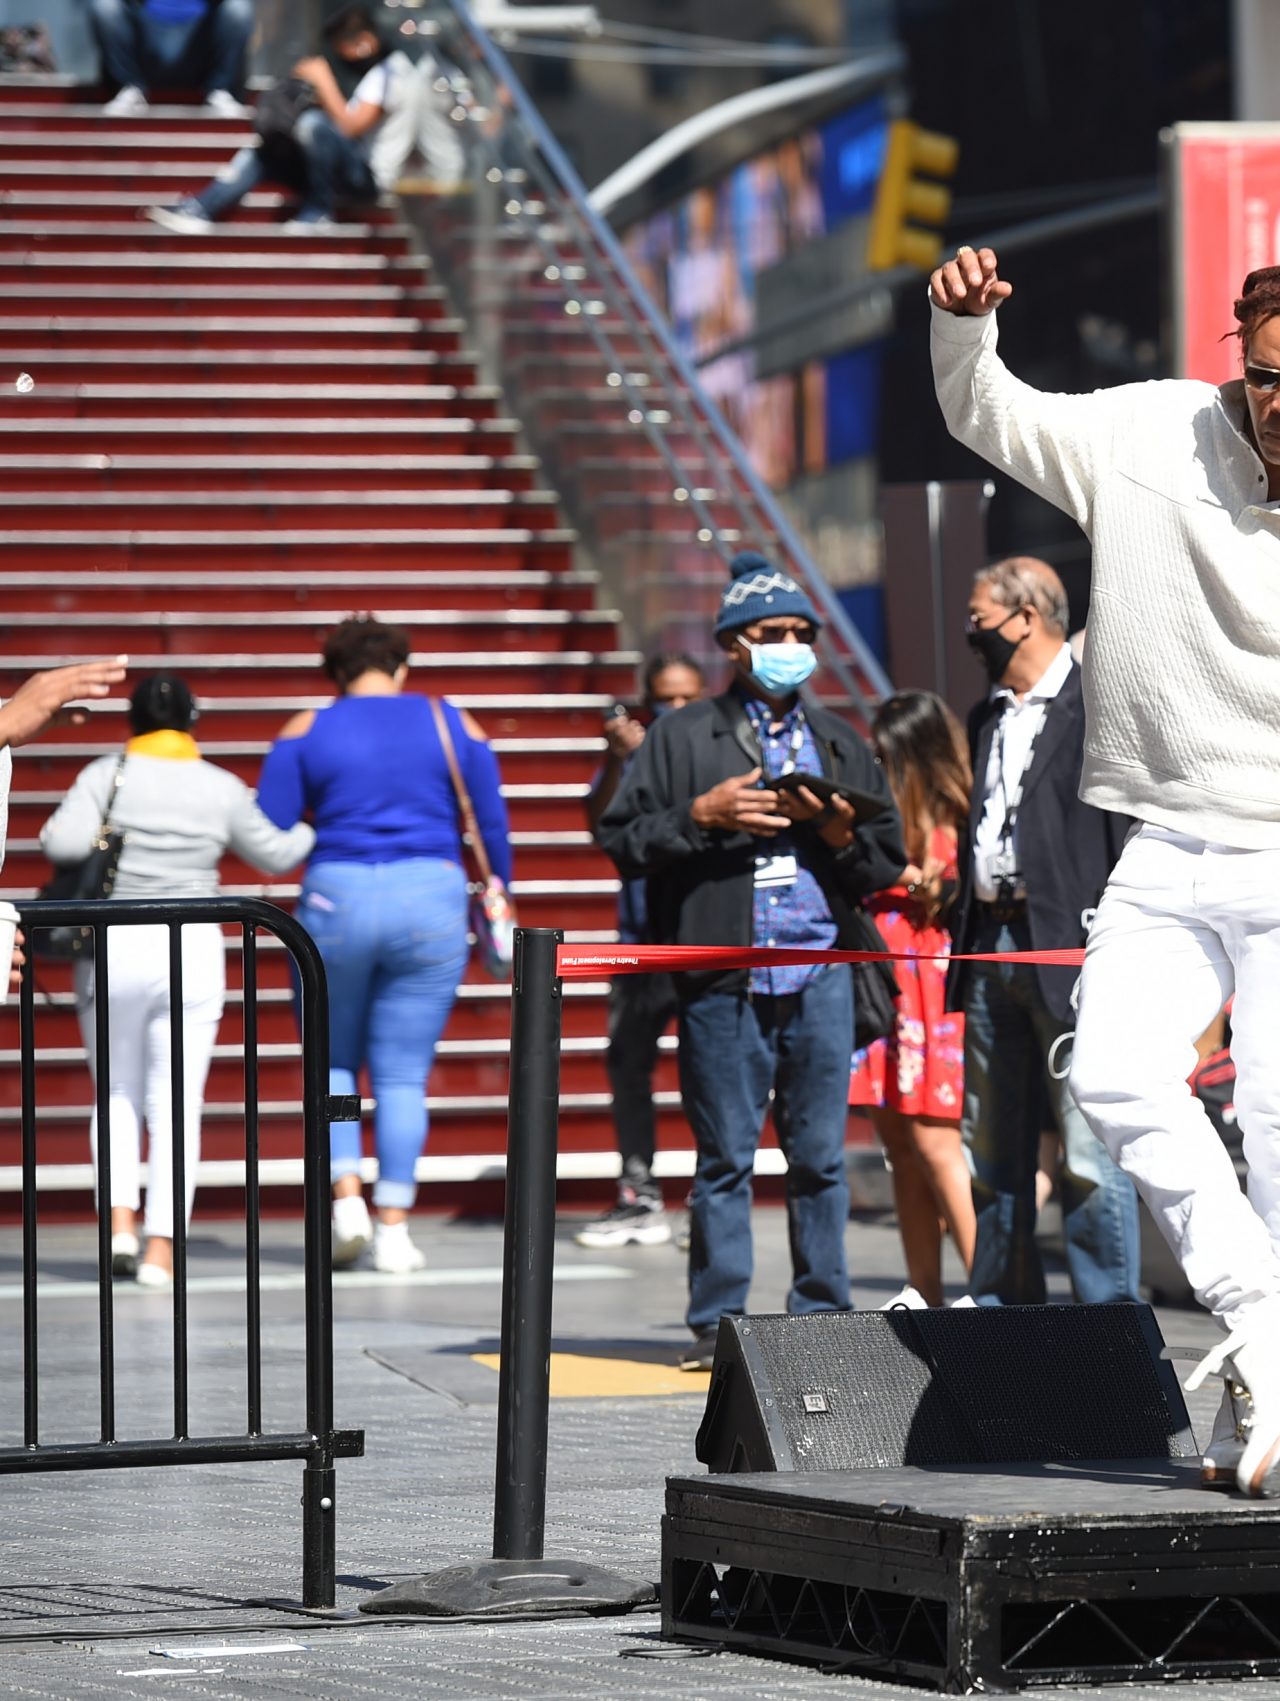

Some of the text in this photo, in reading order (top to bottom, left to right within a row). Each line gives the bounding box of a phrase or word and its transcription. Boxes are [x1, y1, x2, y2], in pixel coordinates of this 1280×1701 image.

[561, 956, 639, 966] Theatre Development Fund
